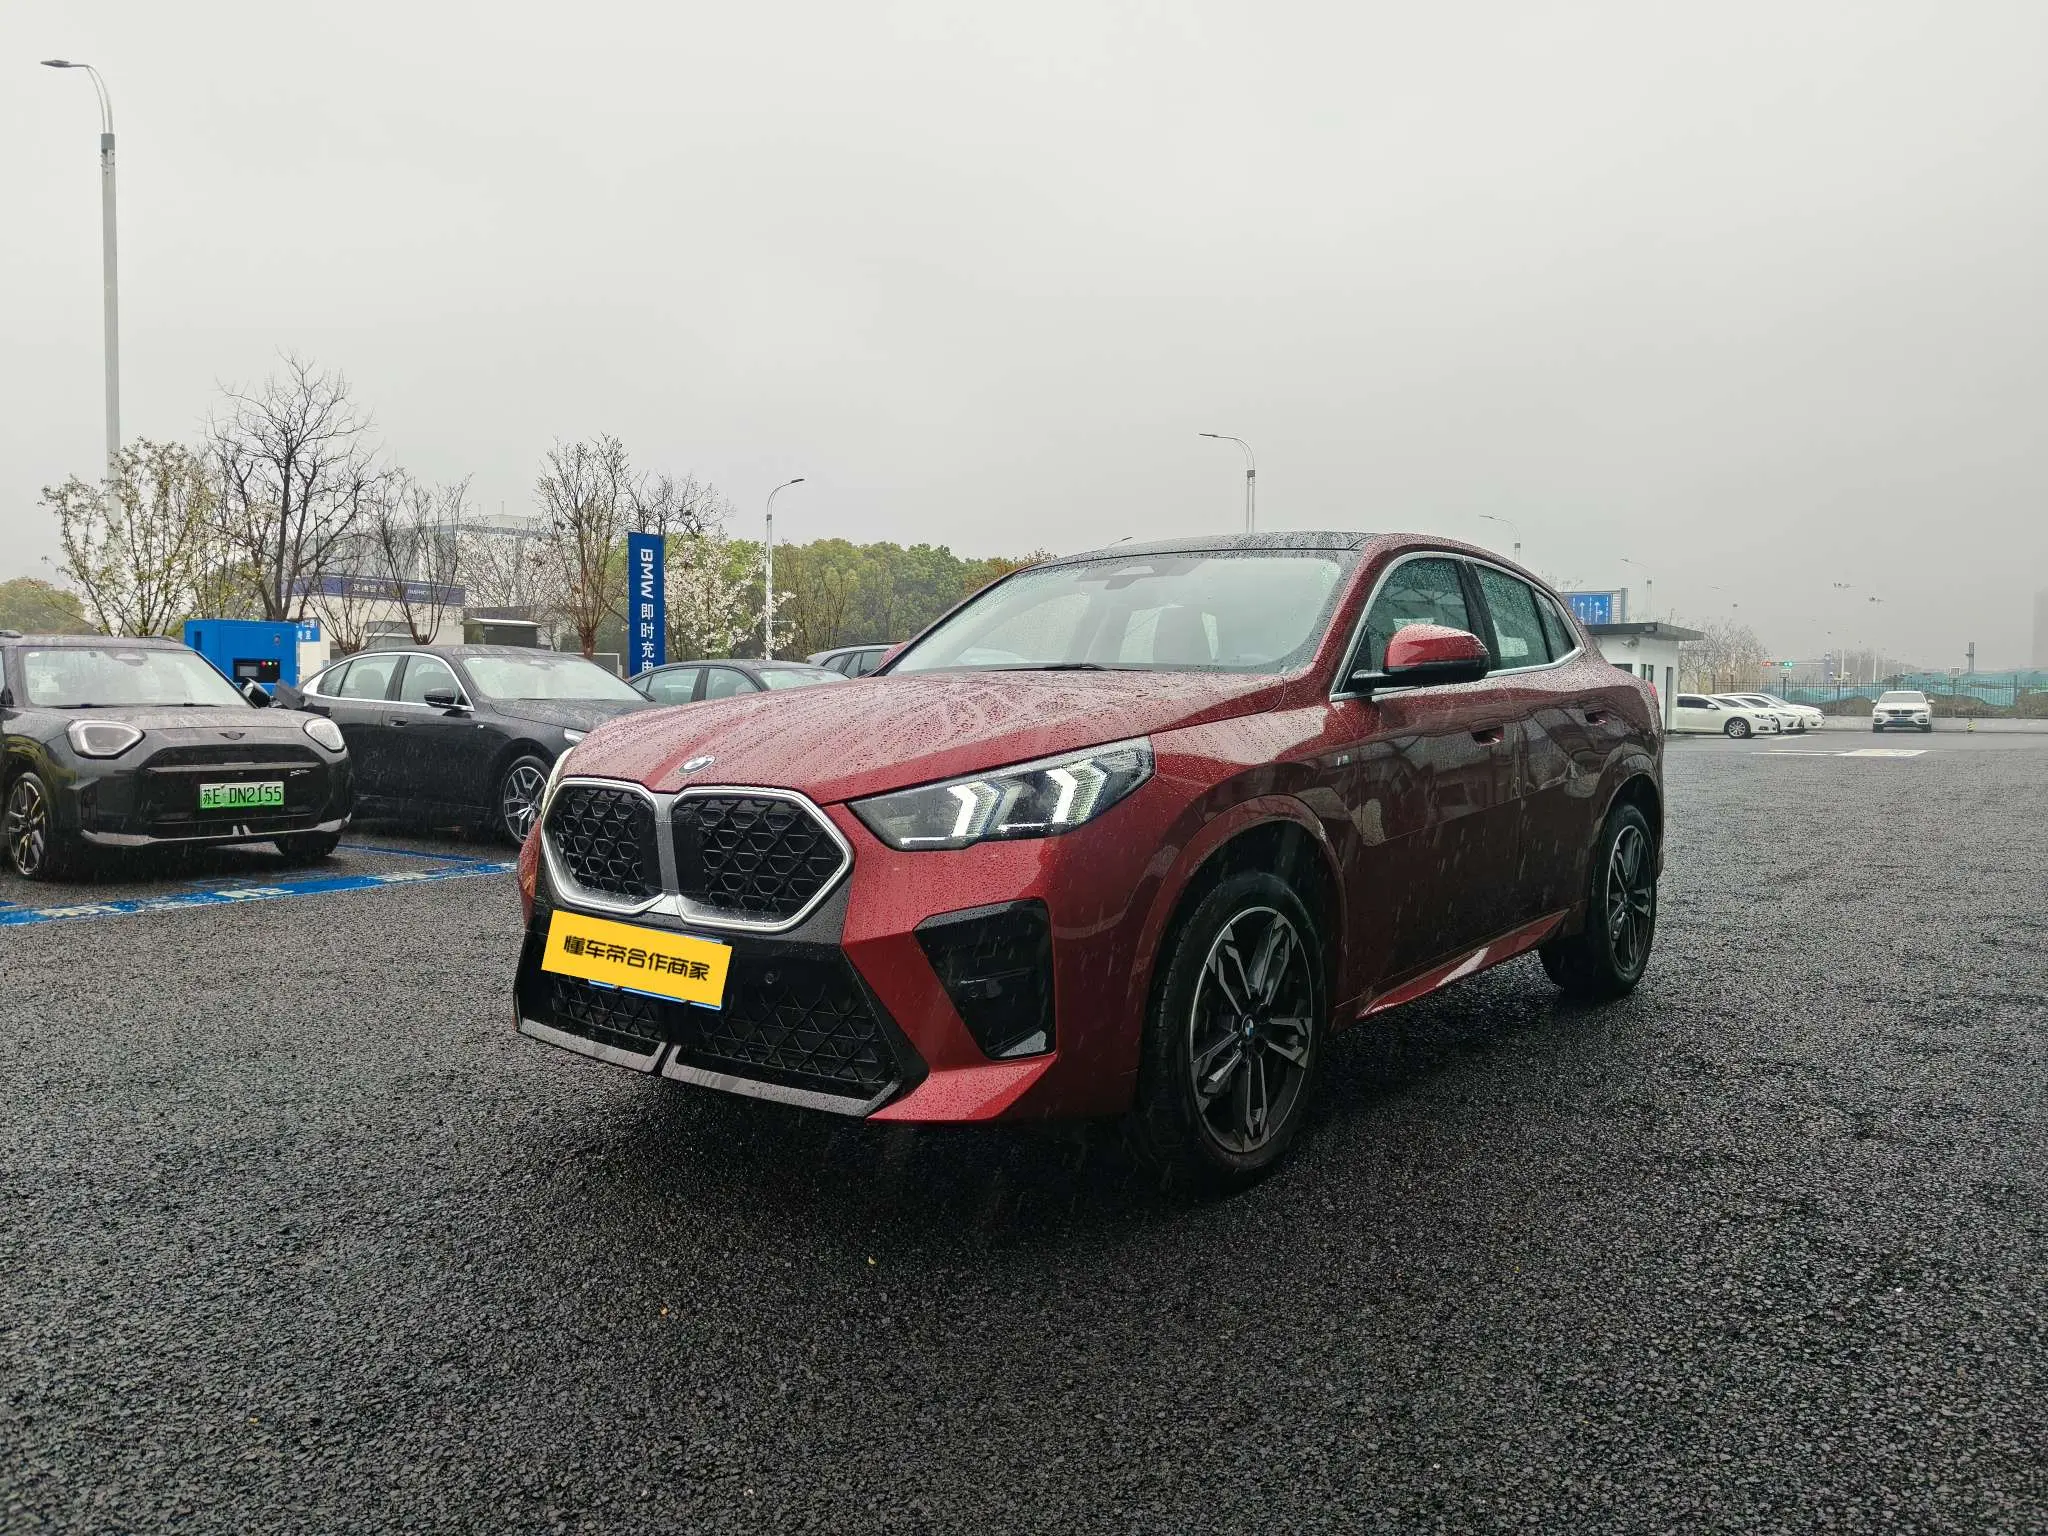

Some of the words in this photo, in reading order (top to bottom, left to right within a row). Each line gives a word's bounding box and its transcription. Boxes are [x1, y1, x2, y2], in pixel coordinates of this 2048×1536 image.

[640, 548, 653, 598] BMW
[640, 603, 655, 673] 即时充电
